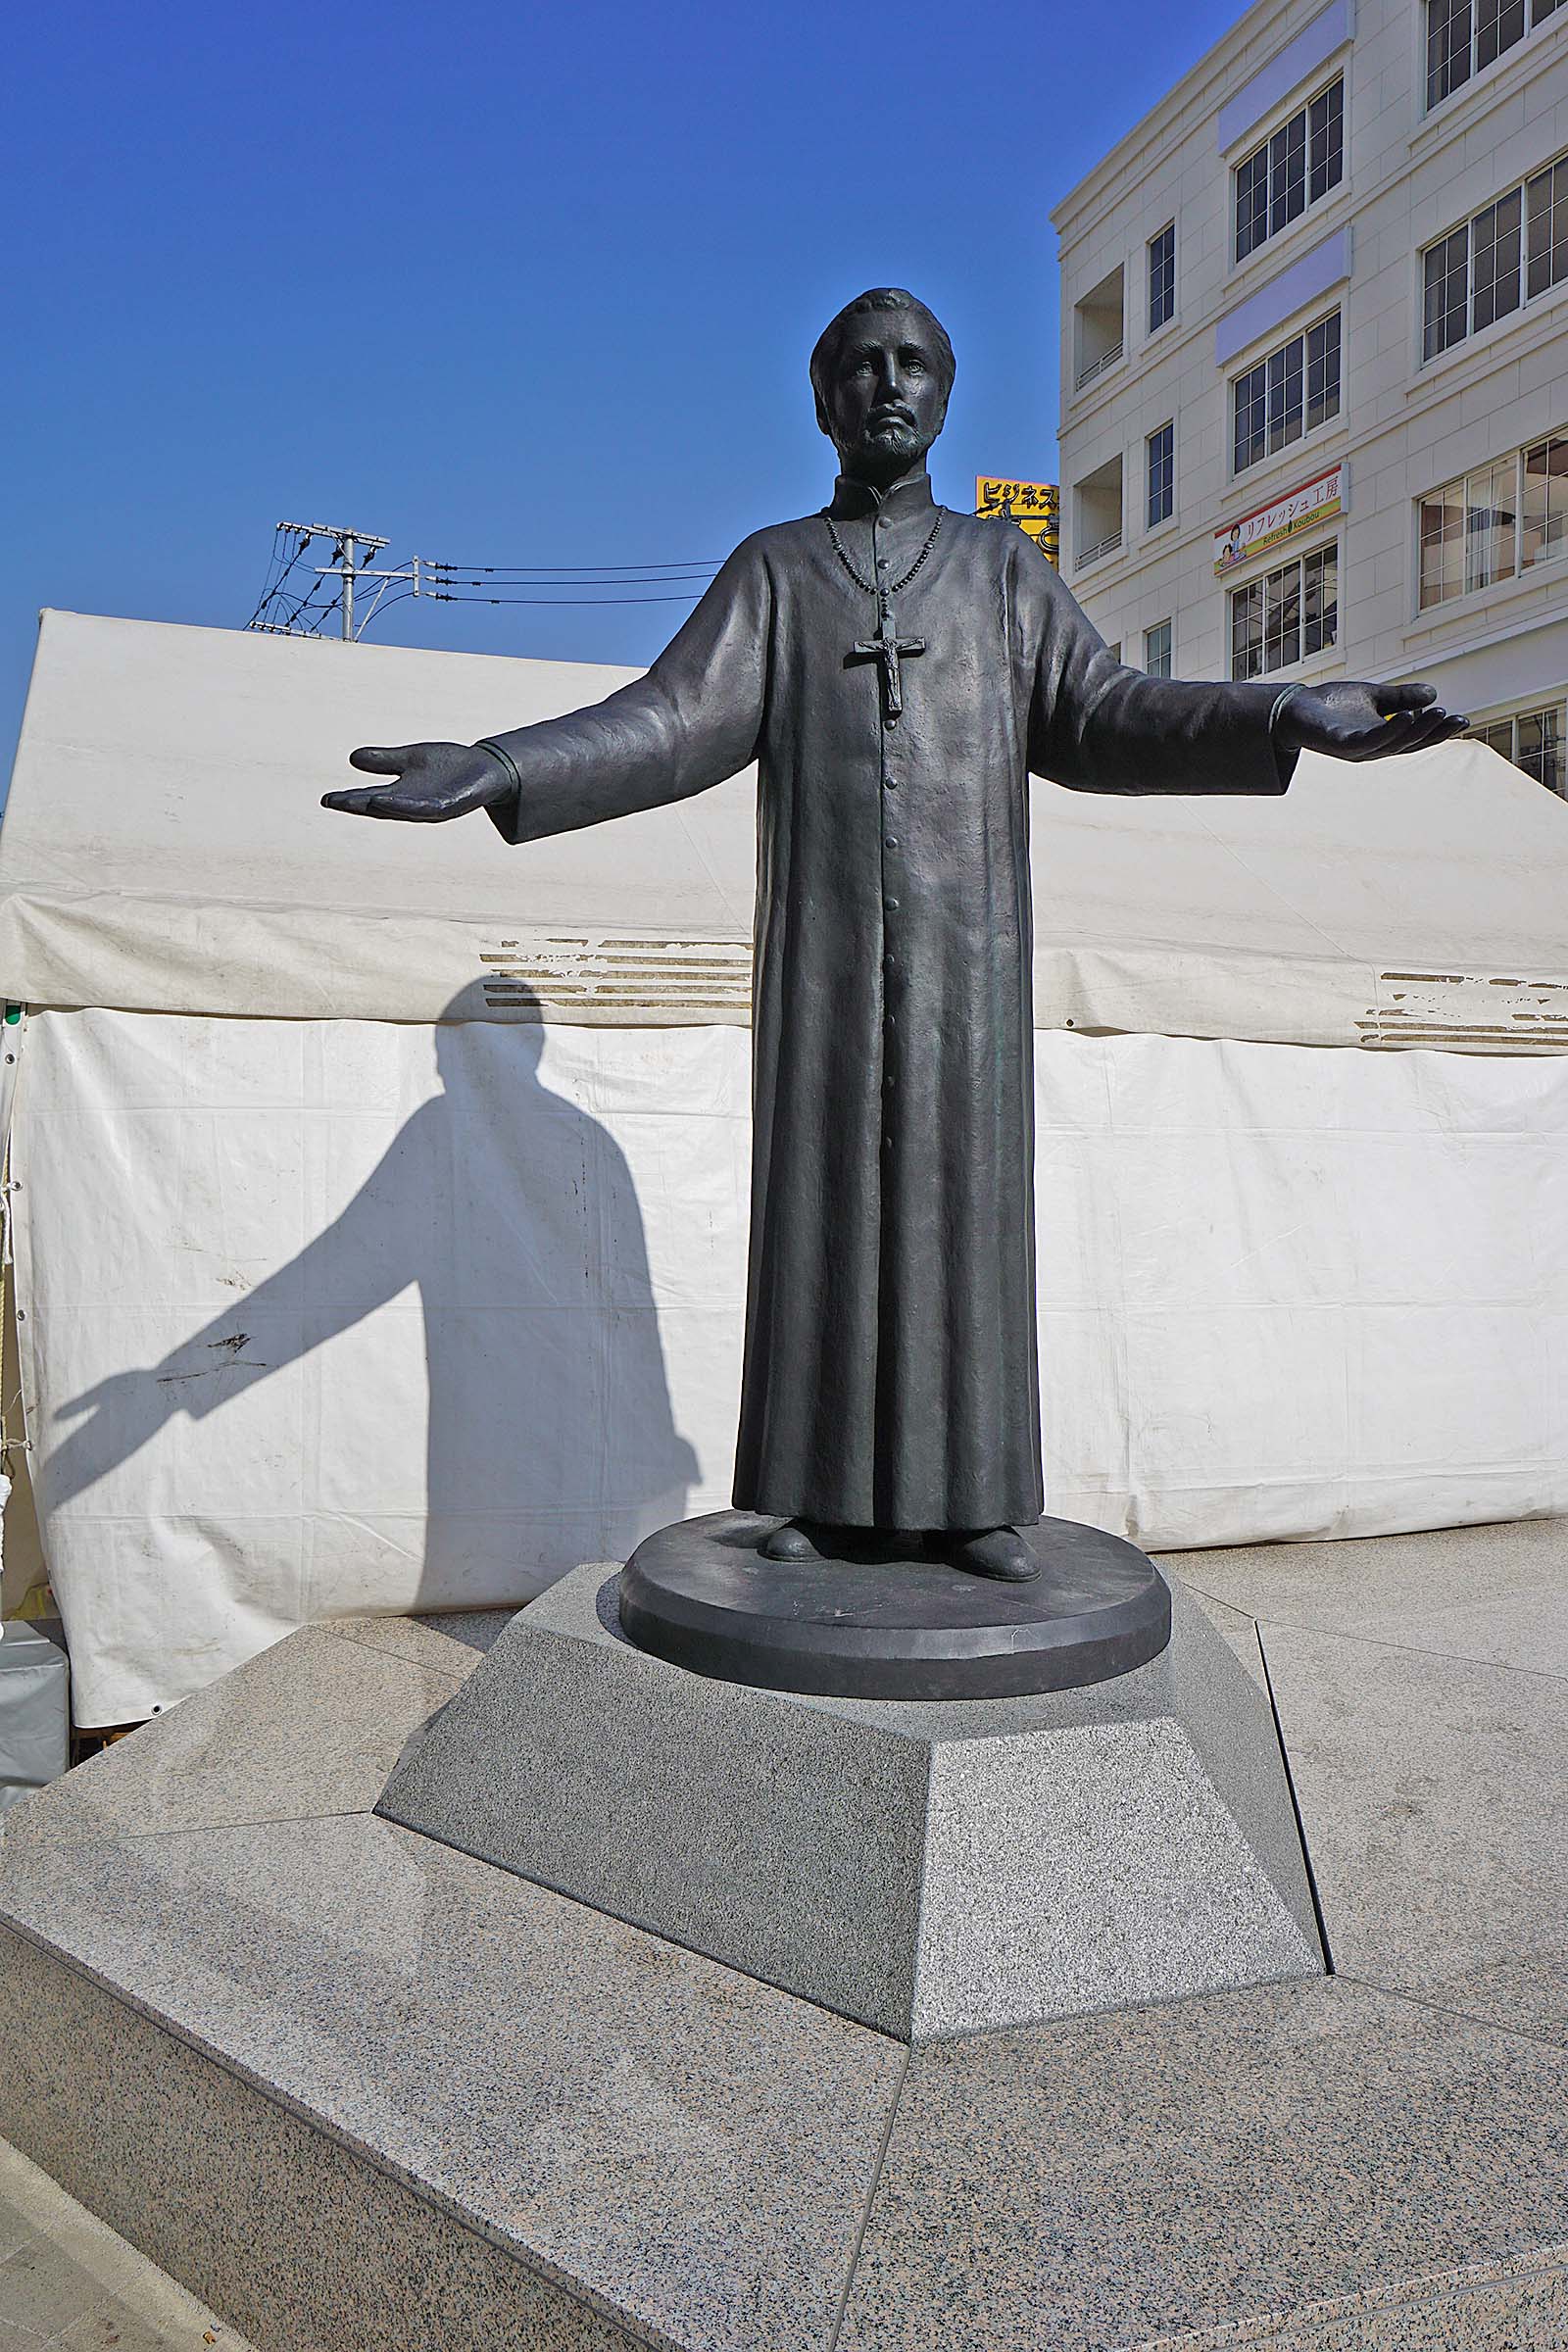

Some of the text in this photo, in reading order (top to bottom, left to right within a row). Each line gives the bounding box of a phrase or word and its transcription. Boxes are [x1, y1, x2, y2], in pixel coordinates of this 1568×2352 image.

[984, 481, 1059, 510] ビジネス
[1248, 475, 1339, 541] リフレッシュ工房
